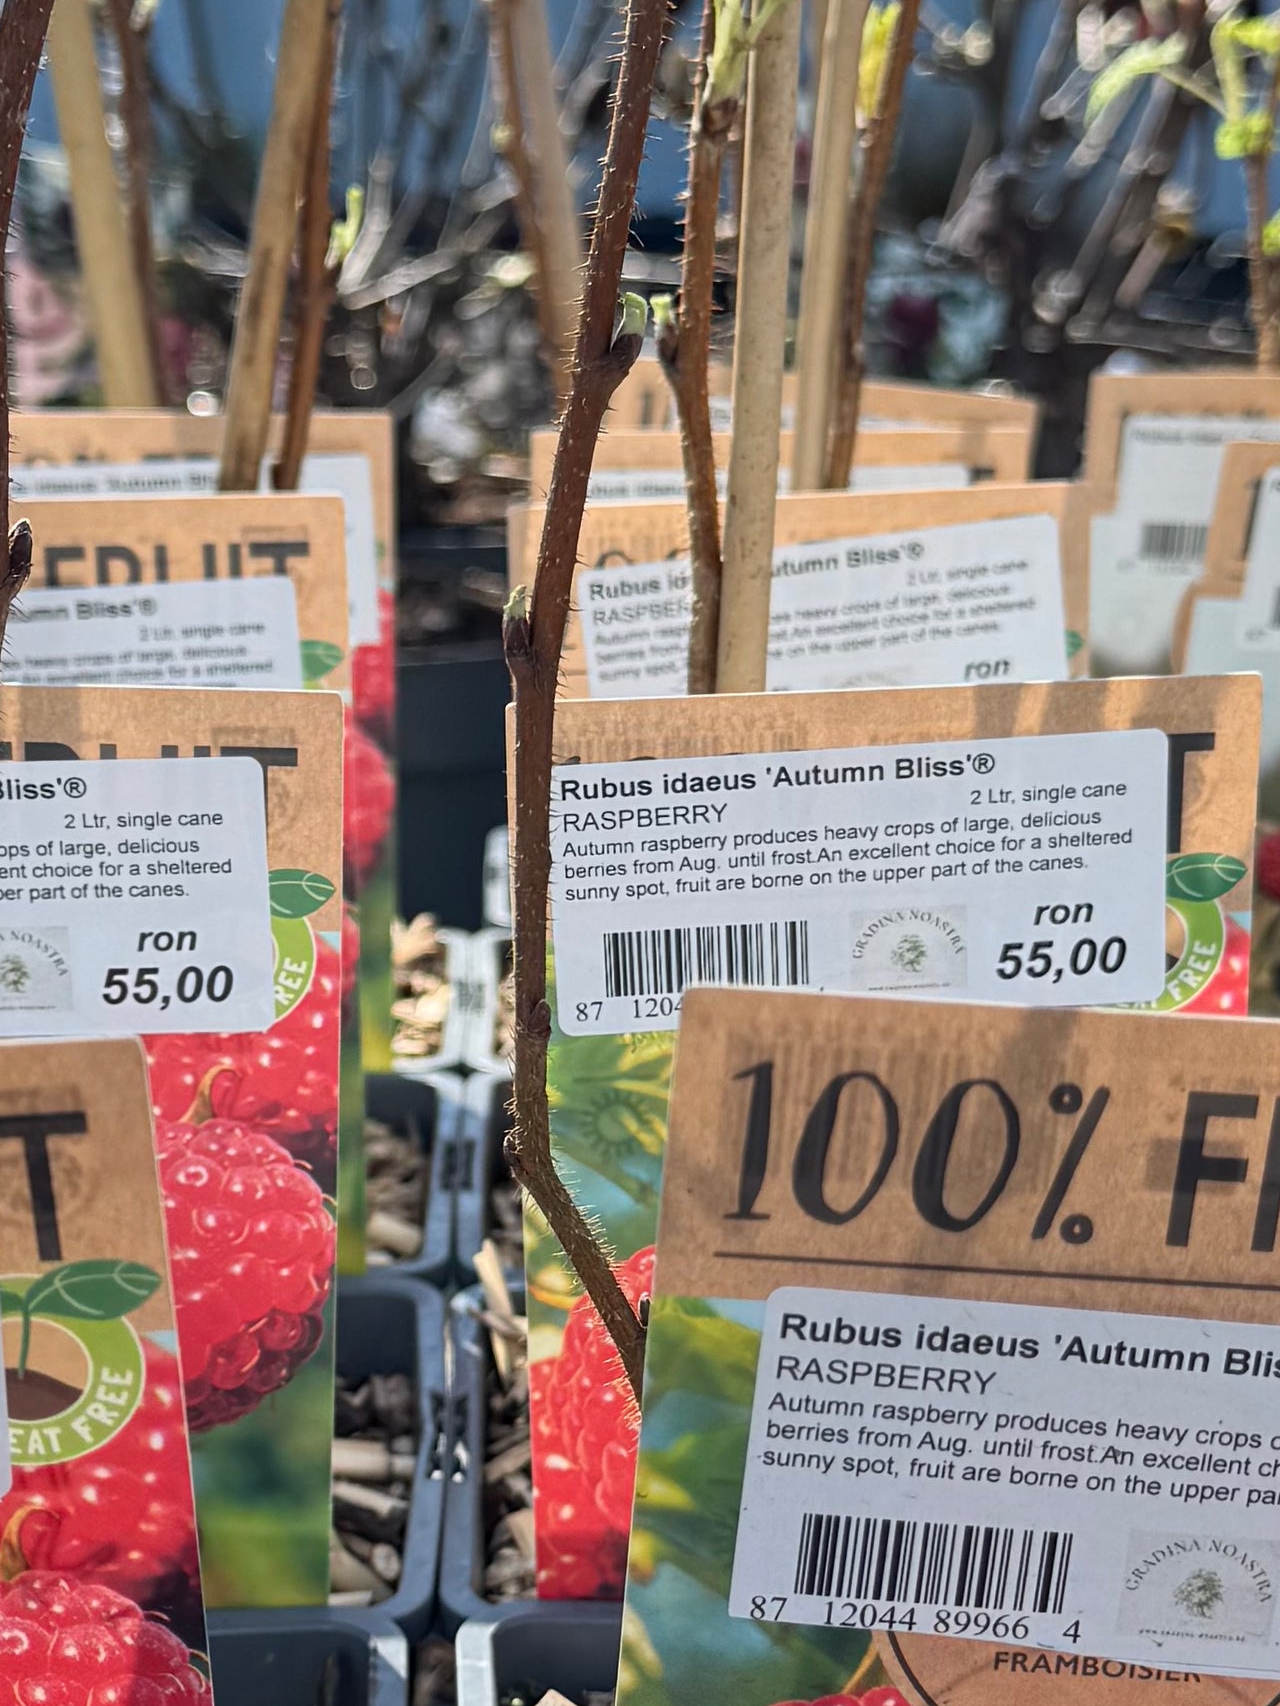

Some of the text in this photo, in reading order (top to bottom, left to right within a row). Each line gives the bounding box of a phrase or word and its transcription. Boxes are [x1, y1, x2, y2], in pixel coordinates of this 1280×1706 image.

[561, 778, 652, 801] Rubus
[663, 773, 756, 794] idaeus
[971, 784, 1126, 805] 2 Ltr, single cane
[64, 812, 222, 830] 2 Ltr, single cane
[563, 803, 727, 832] RASPBERRY
[1034, 903, 1093, 925] ron
[138, 931, 196, 952] ron
[997, 937, 1126, 983] 55,00
[102, 966, 233, 1010] 55,00
[1167, 940, 1216, 1001] FREE
[723, 1060, 1111, 1245] 100%
[781, 1313, 901, 1348] Rubus
[916, 1324, 1039, 1358] idaeus
[777, 1356, 996, 1395] RASPBERRY
[9, 1367, 133, 1455] EAT FREE
[768, 1392, 864, 1417] Autumn
[873, 1404, 988, 1431] raspberry
[995, 1413, 1107, 1436] produces
[1116, 1419, 1189, 1447] heavy
[1196, 1430, 1261, 1451] crops
[749, 1596, 1081, 1643] 87 12044 89966 4
